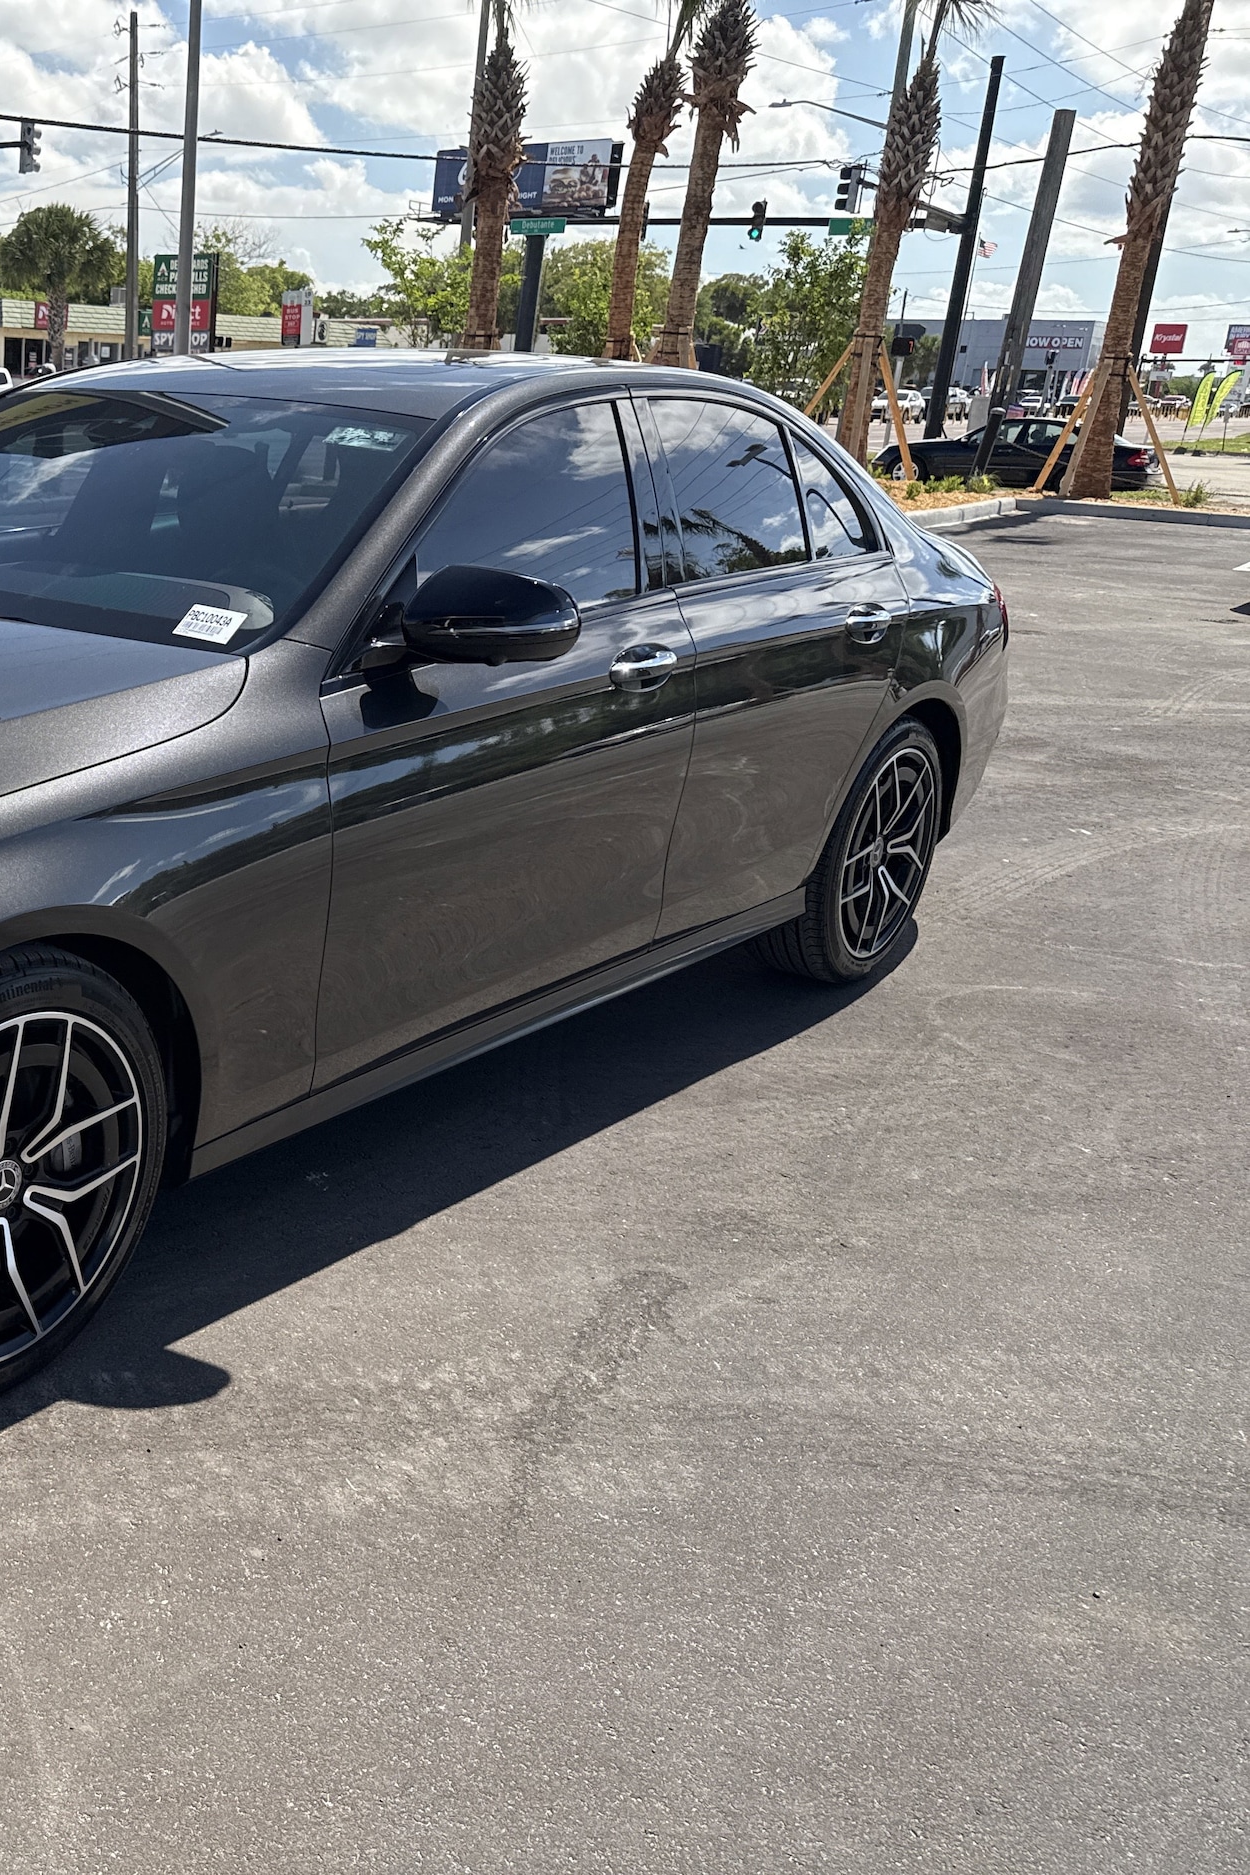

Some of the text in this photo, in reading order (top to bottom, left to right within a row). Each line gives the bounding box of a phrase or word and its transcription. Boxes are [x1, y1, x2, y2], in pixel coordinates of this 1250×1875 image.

[550, 145, 584, 155] WELCOME TO
[521, 220, 555, 230] Debutante
[193, 259, 209, 270] ARDS
[155, 284, 178, 295] CHECK
[161, 304, 201, 320] Dict
[154, 333, 208, 346] SPY OP
[1051, 337, 1084, 348] OPEN
[1154, 333, 1184, 344] Krystal
